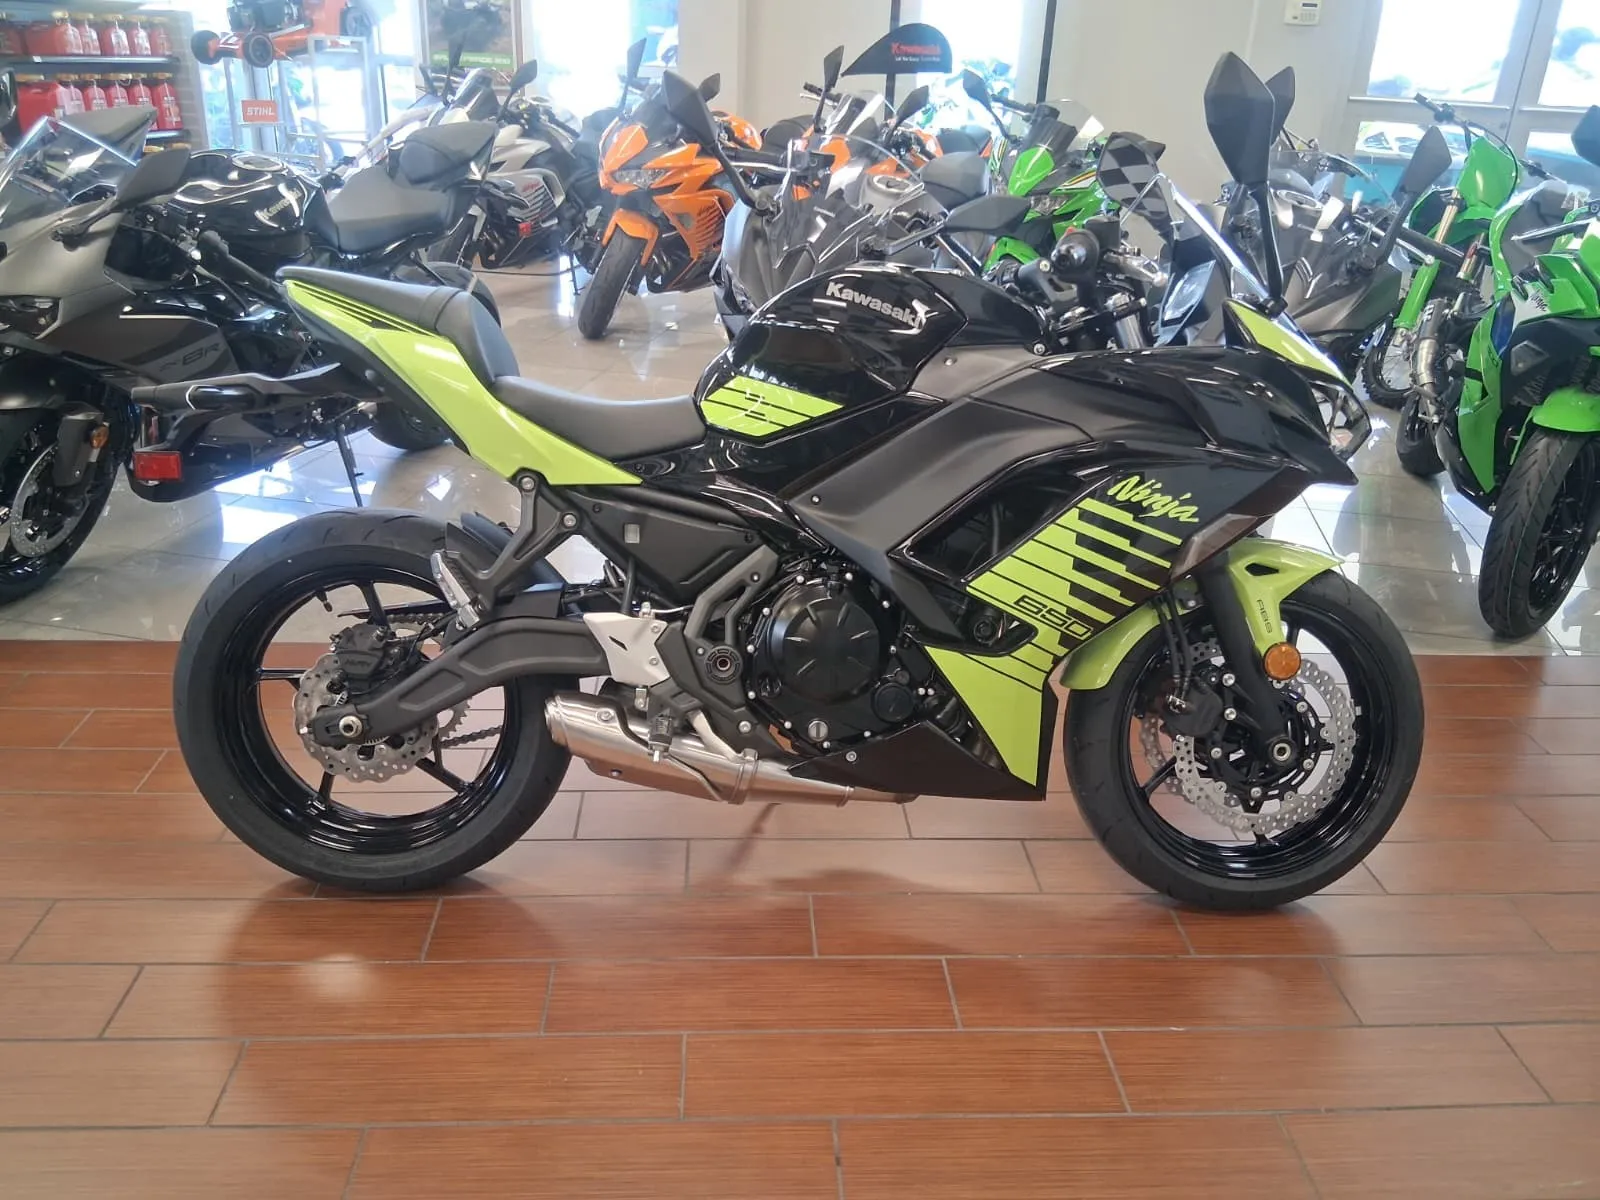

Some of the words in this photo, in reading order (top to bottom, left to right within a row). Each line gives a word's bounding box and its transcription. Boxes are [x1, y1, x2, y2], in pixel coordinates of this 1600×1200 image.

[246, 106, 276, 116] STIHL
[826, 282, 921, 330] Kawasaki
[1107, 475, 1200, 523] Ninja
[1013, 595, 1092, 638] 650
[1256, 599, 1273, 634] ABS
